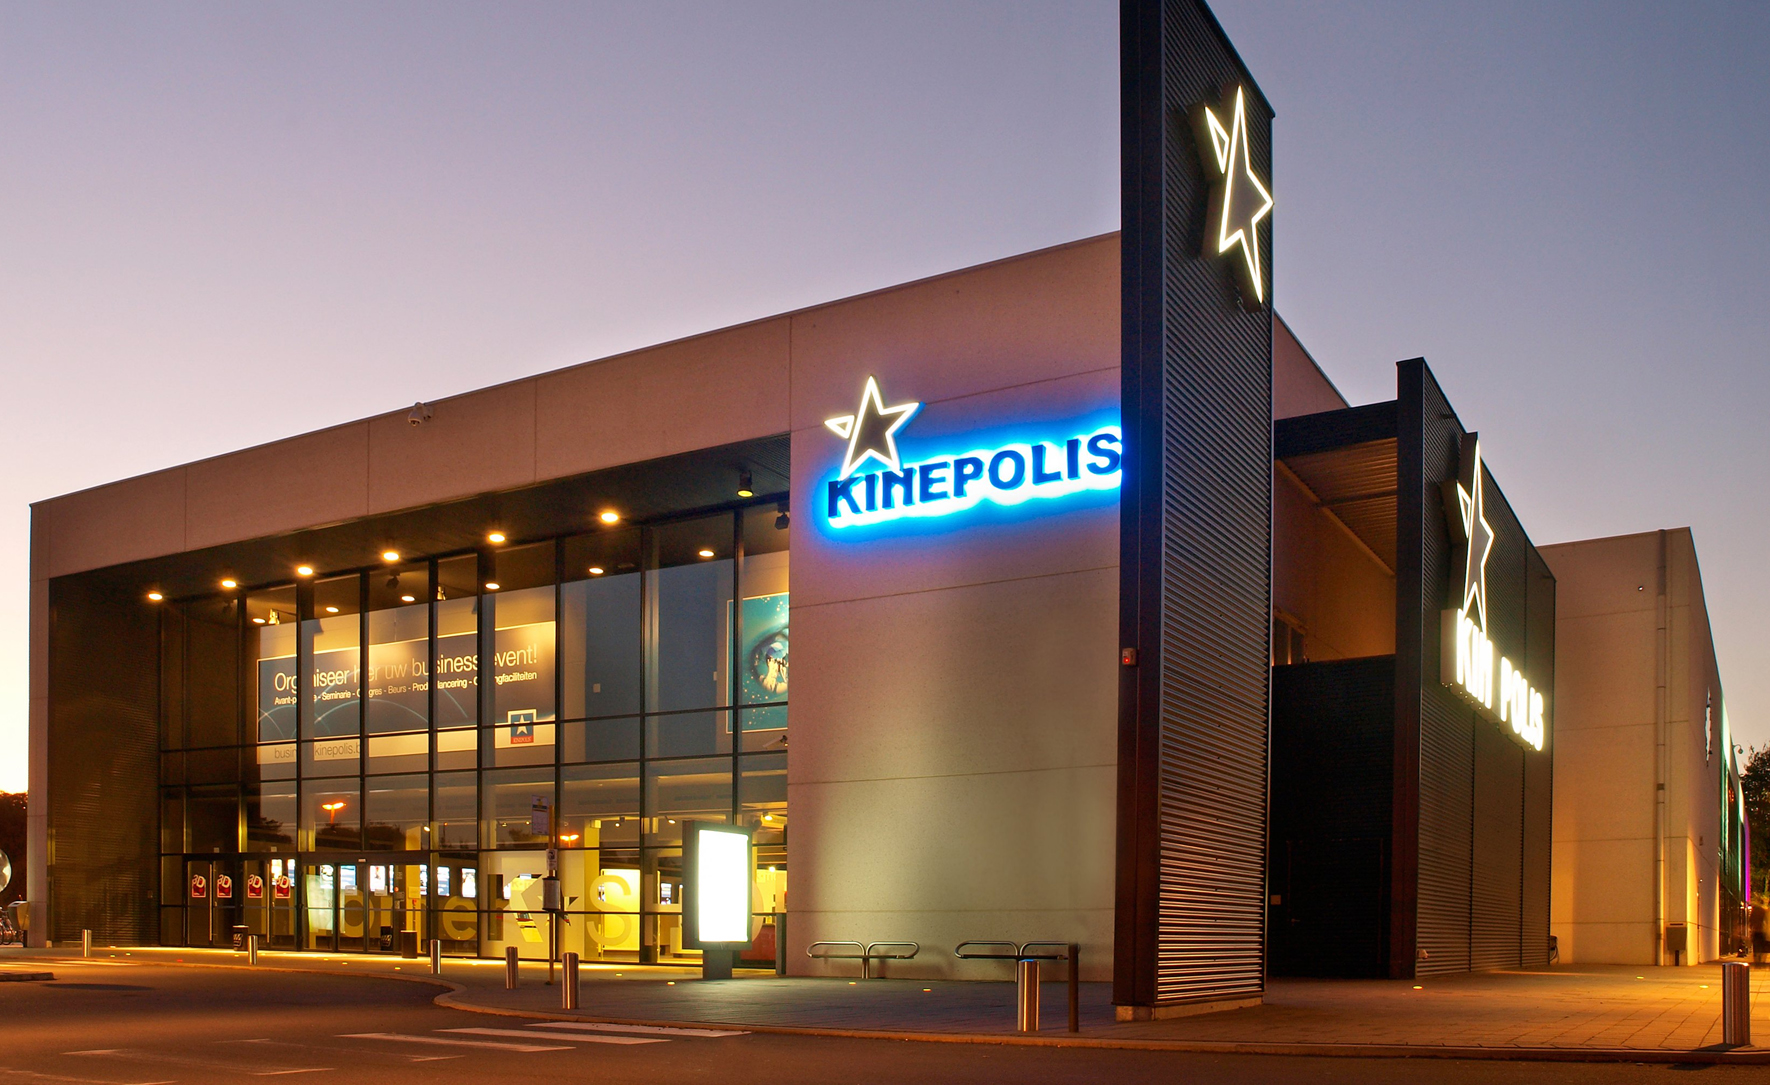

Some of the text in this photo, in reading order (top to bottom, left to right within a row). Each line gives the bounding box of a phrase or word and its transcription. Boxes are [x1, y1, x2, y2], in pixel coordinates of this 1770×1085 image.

[828, 433, 1120, 518] KINEPOLIS
[274, 668, 350, 694] Orgiseer
[353, 664, 380, 683] her
[385, 663, 407, 679] uw
[495, 643, 538, 668] vent!
[357, 687, 382, 698] Cgres
[388, 684, 407, 694] Beurs
[412, 678, 468, 692] Prodlancering
[1456, 608, 1544, 751] KINPOLIS
